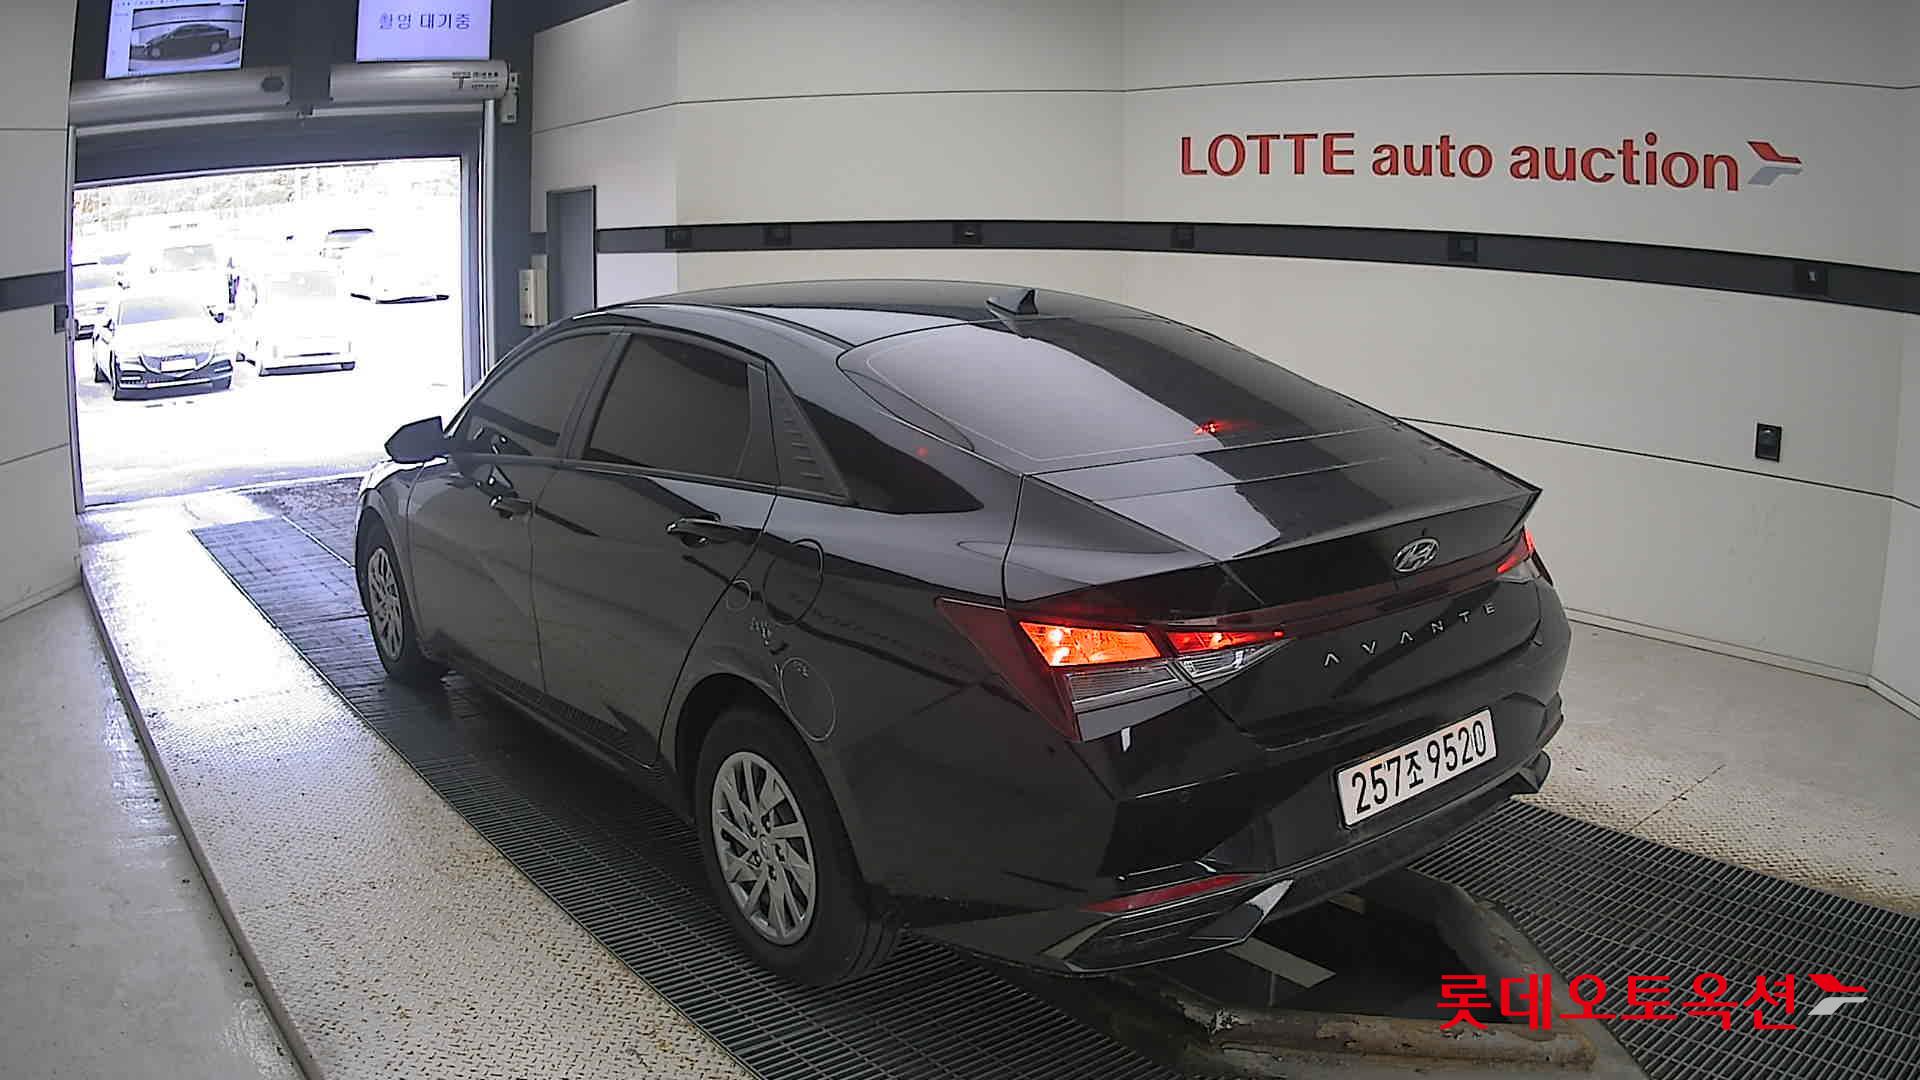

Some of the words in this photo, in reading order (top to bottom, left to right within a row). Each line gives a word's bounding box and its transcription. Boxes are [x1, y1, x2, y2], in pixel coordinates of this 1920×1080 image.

[420, 13, 471, 31] 대기중
[1180, 132, 1355, 177] LOTTE
[1371, 134, 1494, 178] auto
[1509, 132, 1740, 192] auction
[1323, 602, 1497, 668] AVANTE
